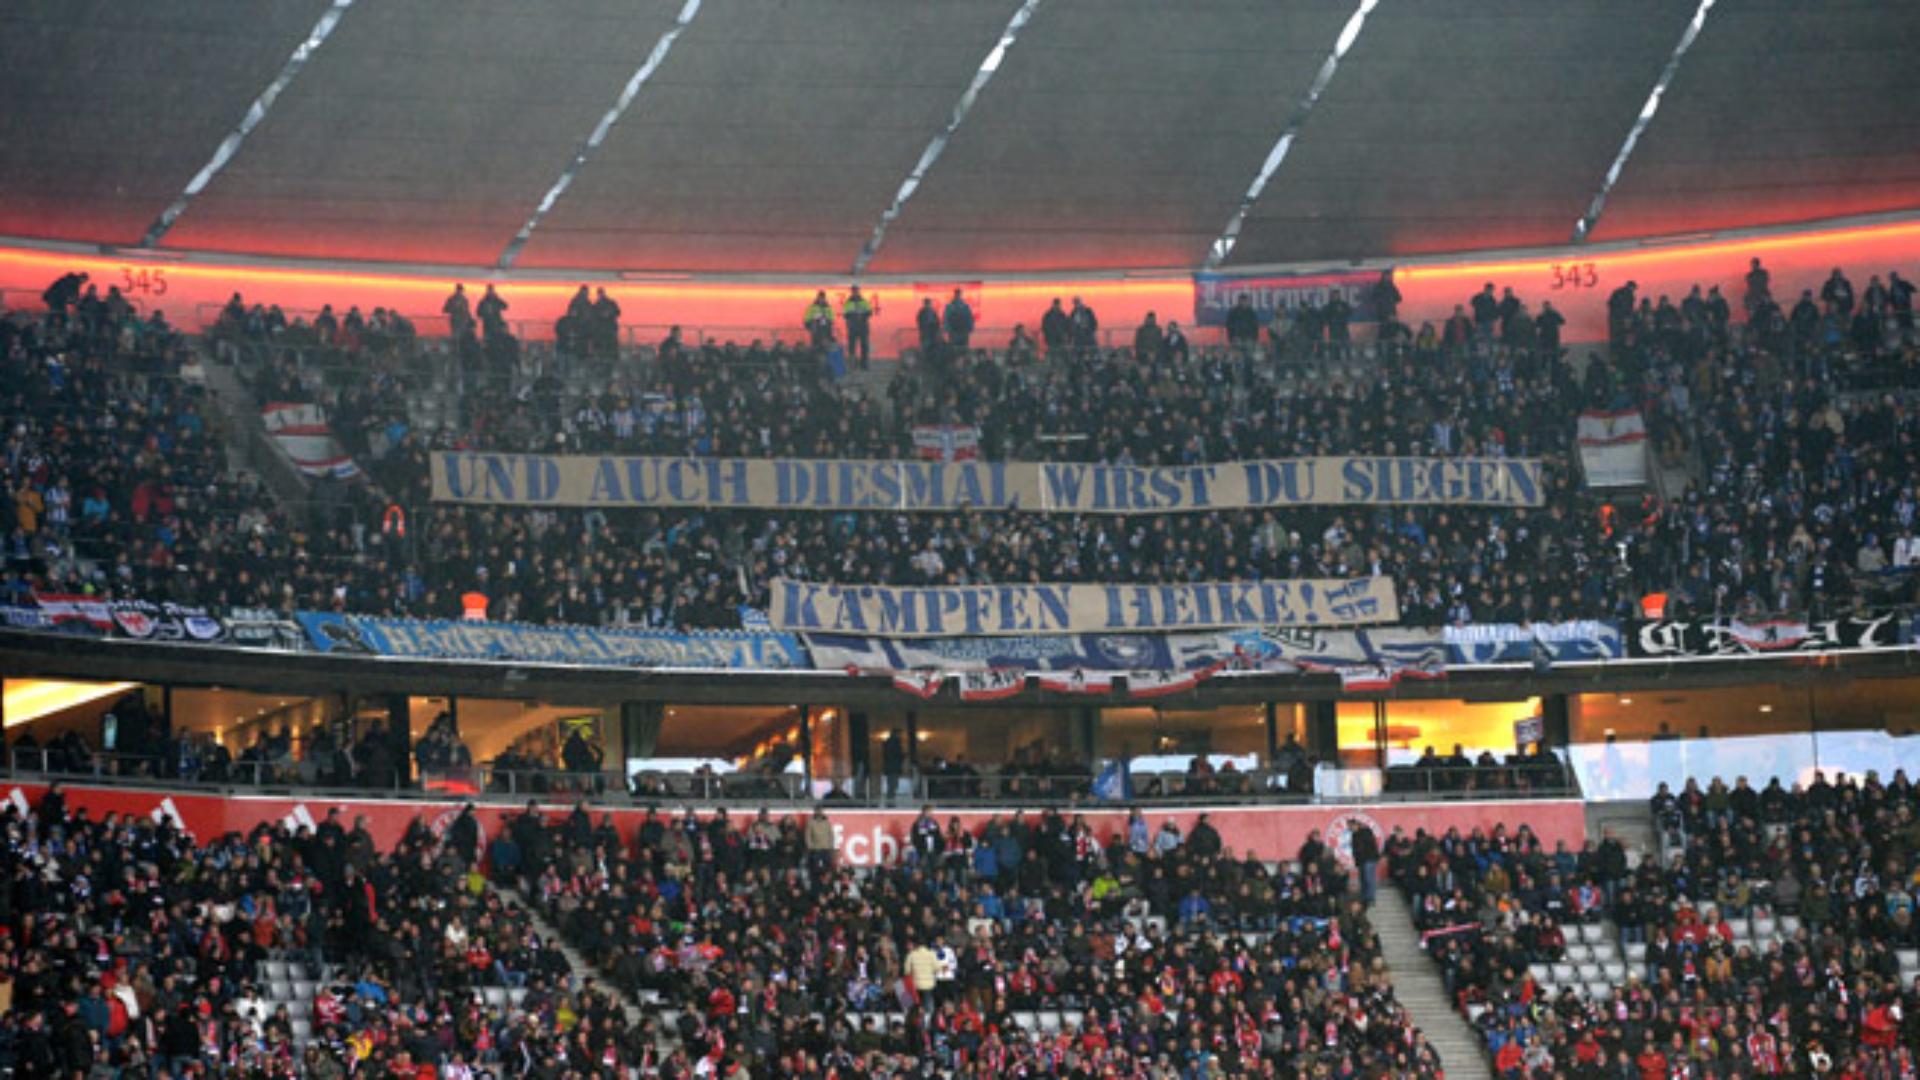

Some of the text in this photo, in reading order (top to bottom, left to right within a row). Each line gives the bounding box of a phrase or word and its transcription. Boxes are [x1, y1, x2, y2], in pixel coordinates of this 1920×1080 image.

[119, 267, 168, 296] 345
[1549, 263, 1599, 290] 343
[444, 453, 1542, 508] UND AUCH DIESMAL WIRST DU SIEGEN
[782, 582, 1318, 633] KÄMPFEN HEIKE!
